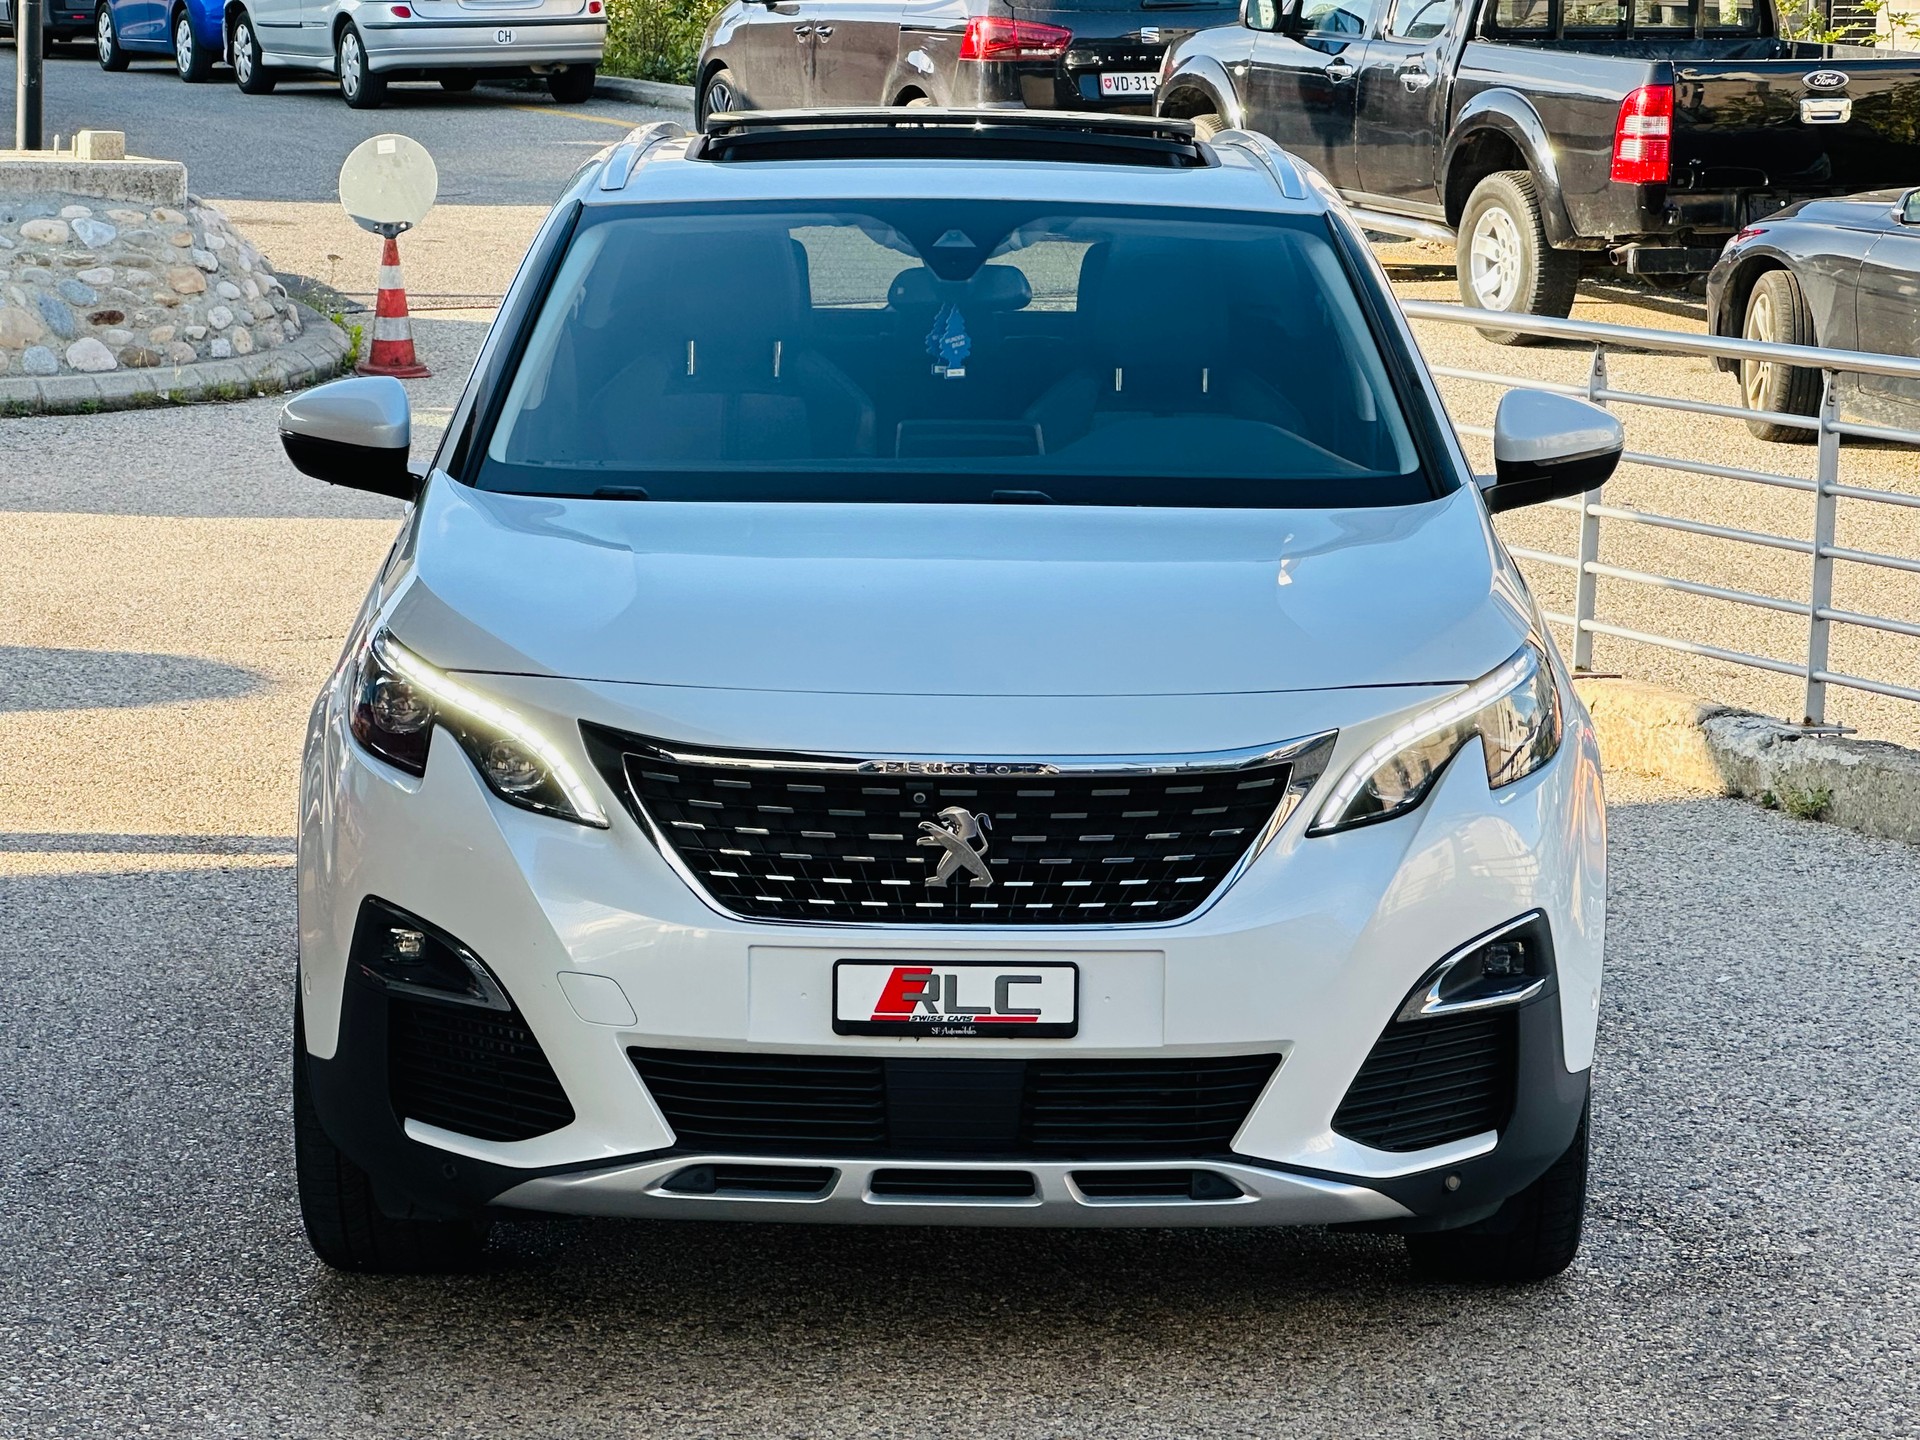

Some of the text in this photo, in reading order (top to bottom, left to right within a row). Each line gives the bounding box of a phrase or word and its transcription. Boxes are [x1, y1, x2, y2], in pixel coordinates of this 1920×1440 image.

[498, 30, 512, 42] CH
[1814, 73, 1839, 85] Ford
[884, 762, 1035, 775] PEUGEOT
[941, 1025, 977, 1035] Automobiles
